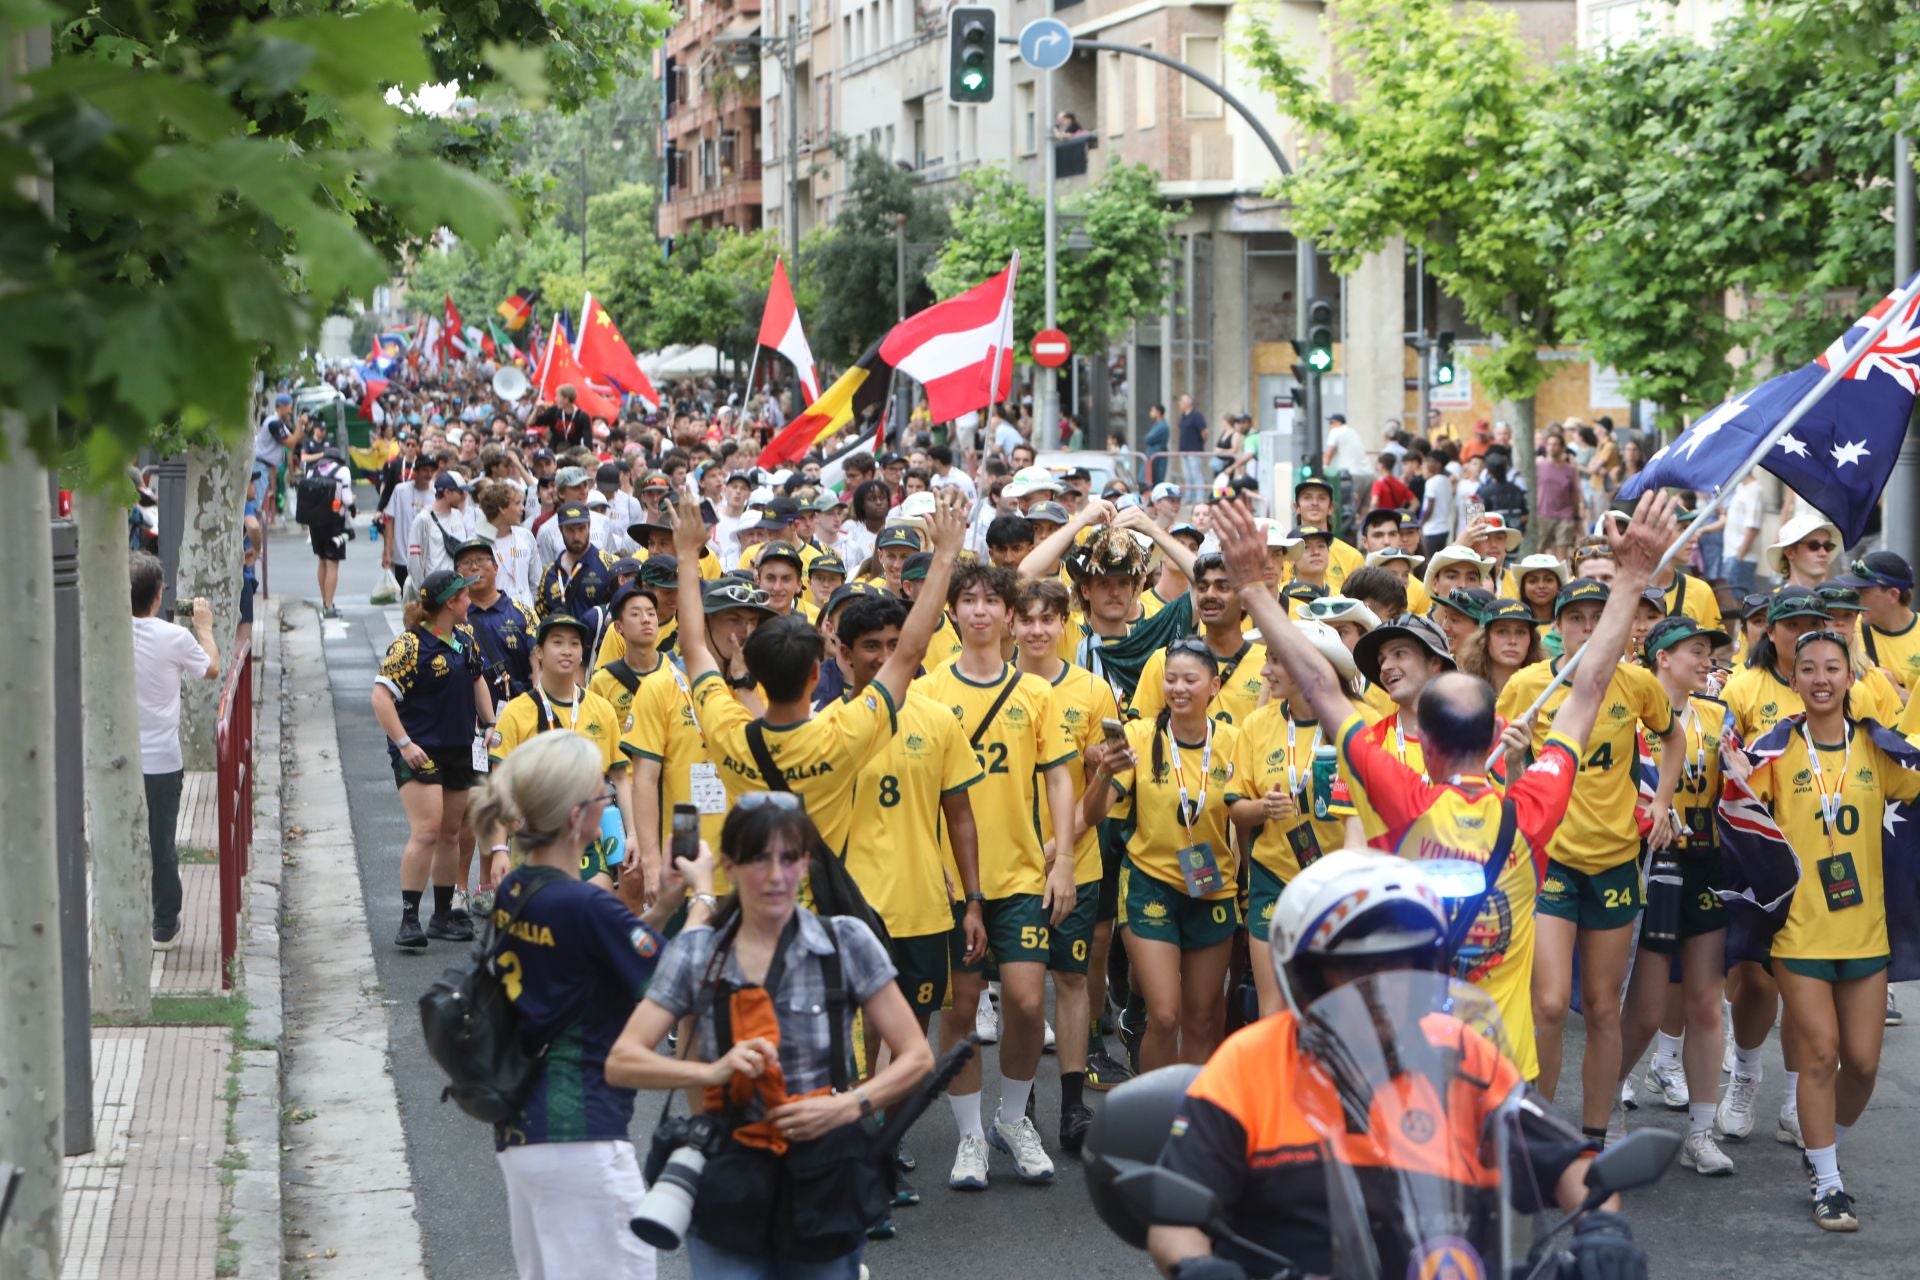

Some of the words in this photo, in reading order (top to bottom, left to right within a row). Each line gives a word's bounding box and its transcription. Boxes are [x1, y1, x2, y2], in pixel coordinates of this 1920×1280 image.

[723, 755, 834, 780] AUSALIA
[1580, 742, 1613, 772] 4
[1266, 767, 1284, 775] AFDA
[879, 774, 901, 808] 8
[1793, 786, 1813, 795] AFDA
[1814, 804, 1860, 836] 10
[1604, 886, 1632, 908] 24
[1212, 905, 1227, 924] 0
[1020, 925, 1050, 950] 52
[917, 982, 934, 1005] 8
